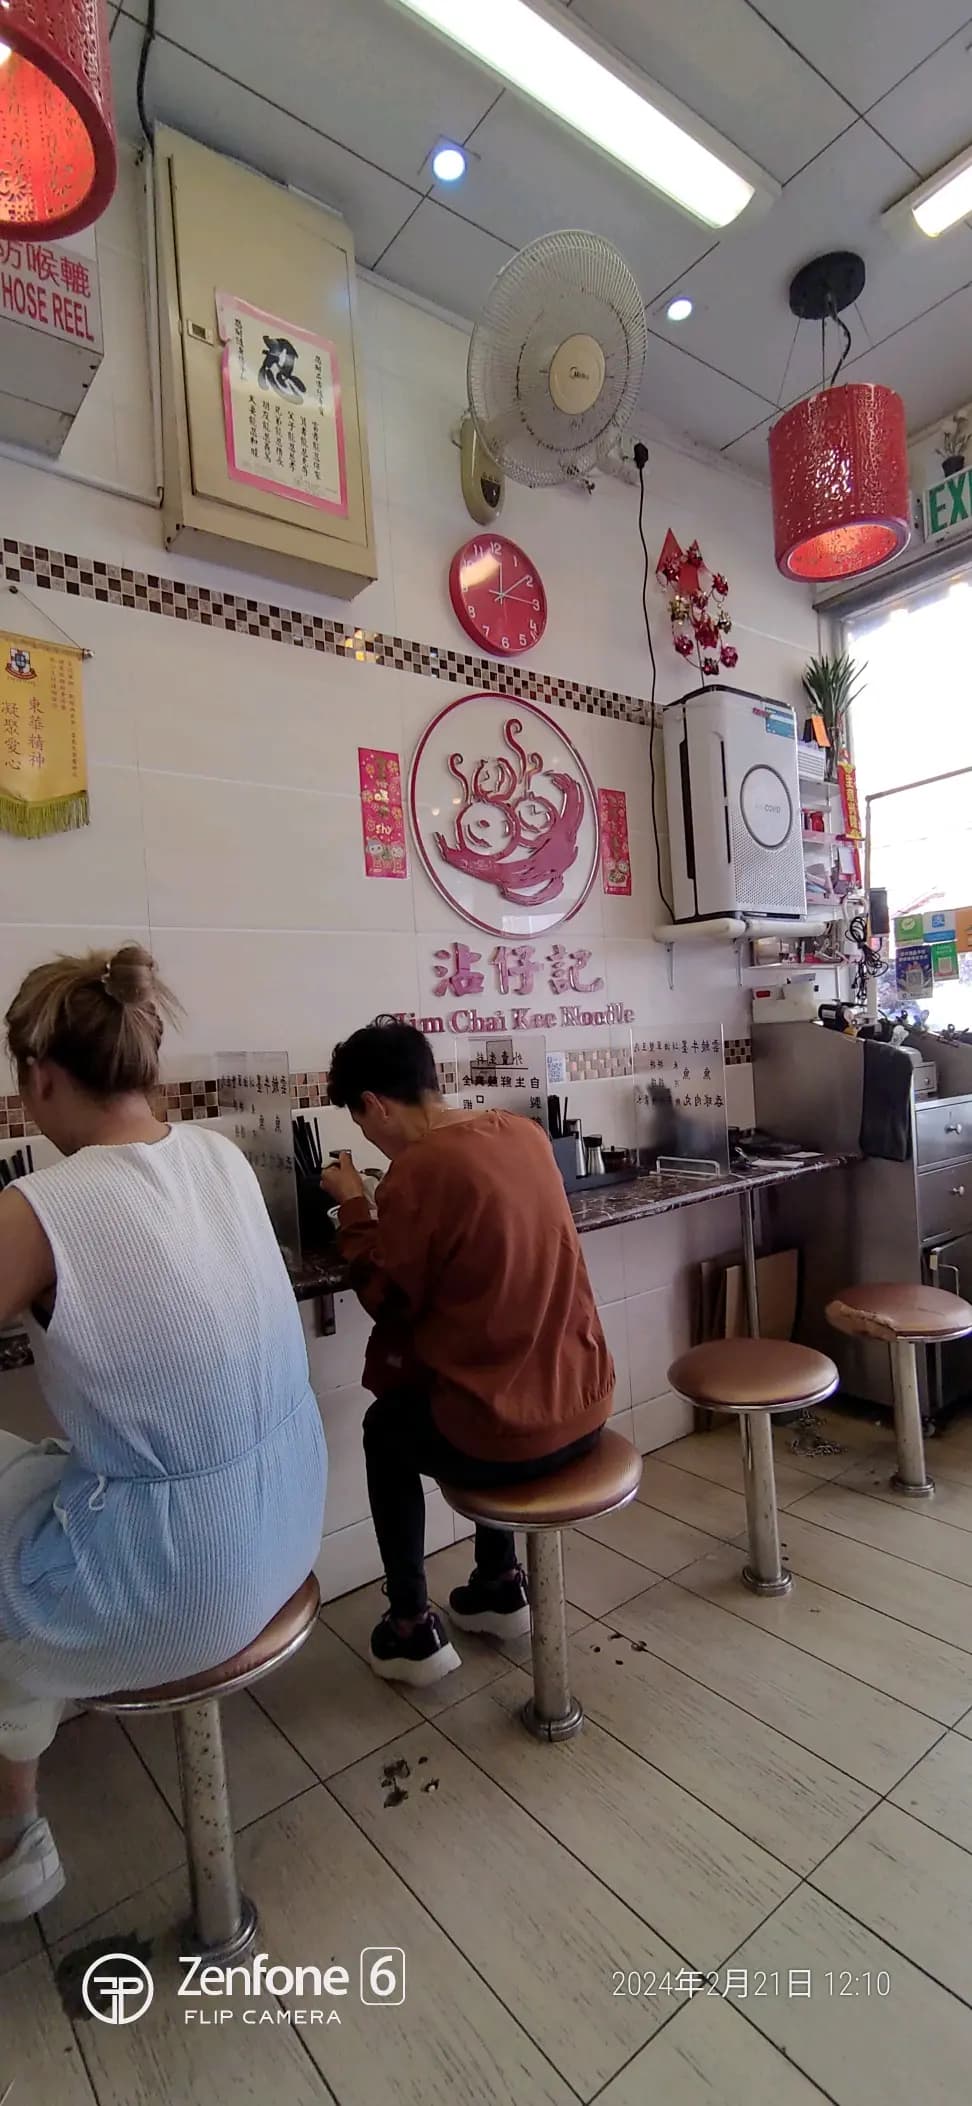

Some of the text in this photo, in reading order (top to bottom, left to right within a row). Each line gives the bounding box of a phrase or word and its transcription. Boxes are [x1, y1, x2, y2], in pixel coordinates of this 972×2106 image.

[1, 272, 94, 342] HOSE REEL
[473, 543, 484, 558] 11
[490, 542, 502, 555] 12
[513, 556, 518, 567] 1
[526, 577, 533, 588] 2
[467, 606, 476, 618] 8
[532, 600, 540, 611] 3
[482, 625, 490, 639] 7
[501, 637, 510, 649] 6
[519, 634, 527, 646] 5
[28, 696, 45, 768] 東華精神
[431, 942, 604, 997] 沾仔記
[448, 1009, 507, 1034] Chai
[511, 1007, 557, 1030] Kee
[560, 1002, 634, 1026] Noodle
